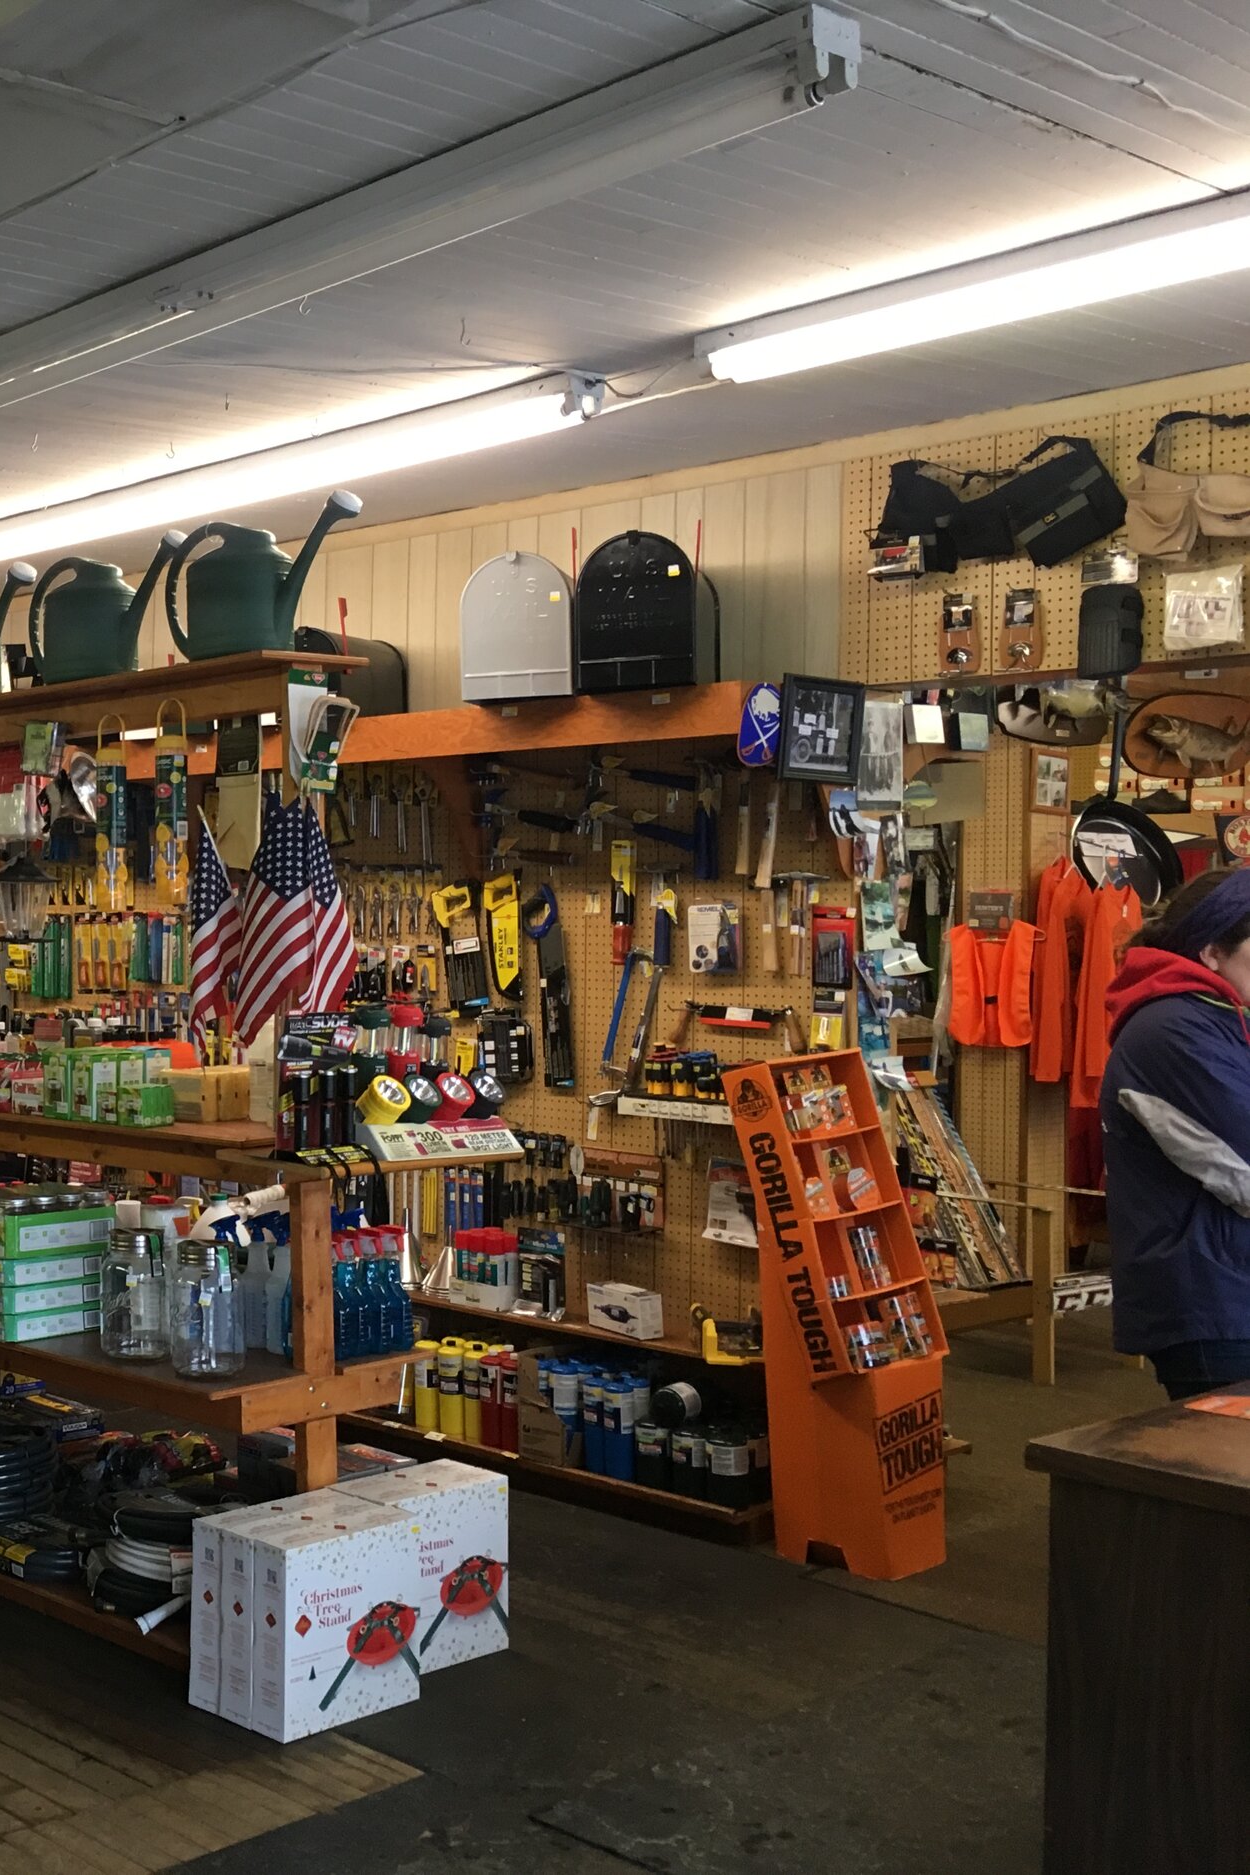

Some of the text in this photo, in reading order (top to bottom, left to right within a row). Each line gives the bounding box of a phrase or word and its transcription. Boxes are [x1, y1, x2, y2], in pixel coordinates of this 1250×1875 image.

[334, 1034, 354, 1047] TV
[737, 1100, 768, 1114] GORILLA
[416, 1131, 443, 1142] 300
[480, 1131, 507, 1140] METER
[492, 1142, 514, 1150] LIGHT
[748, 1132, 836, 1374] GORILLA TOUGH
[6, 1385, 14, 1394] 20
[879, 1397, 940, 1448] GORILLA
[882, 1428, 943, 1487] TOUGH
[304, 1583, 363, 1606] Christmas
[313, 1602, 342, 1617] Tree
[318, 1606, 352, 1628] Stand
